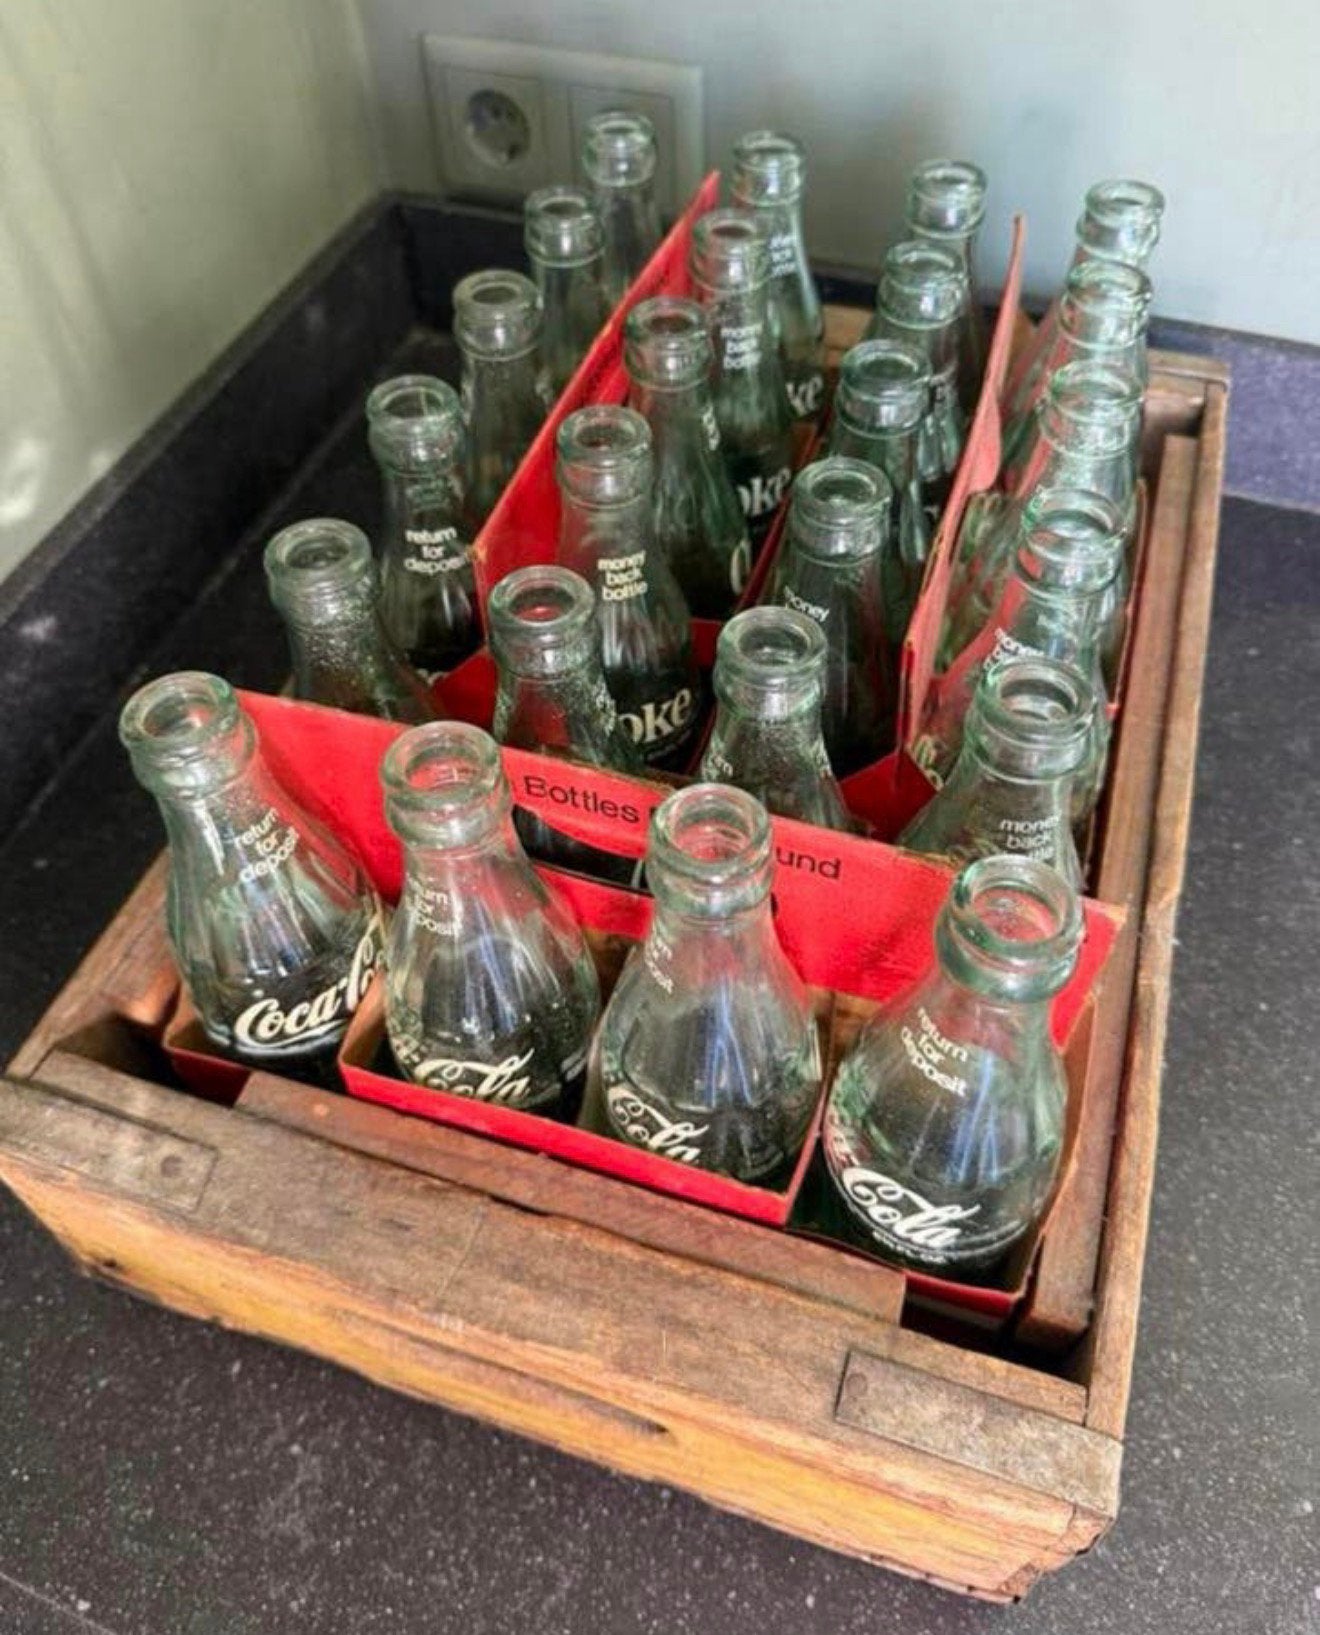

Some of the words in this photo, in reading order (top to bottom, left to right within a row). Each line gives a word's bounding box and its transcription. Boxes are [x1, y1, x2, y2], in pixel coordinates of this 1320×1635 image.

[405, 526, 458, 545] return
[421, 545, 445, 560] for
[597, 549, 647, 570] money
[605, 567, 643, 586] back
[602, 581, 648, 601] bottle
[617, 688, 692, 744] oke
[233, 806, 279, 850] return
[523, 775, 640, 824] Bottles
[775, 846, 841, 880] und
[239, 826, 300, 883] deposit
[254, 831, 280, 857] for
[901, 1026, 967, 1096] deposit
